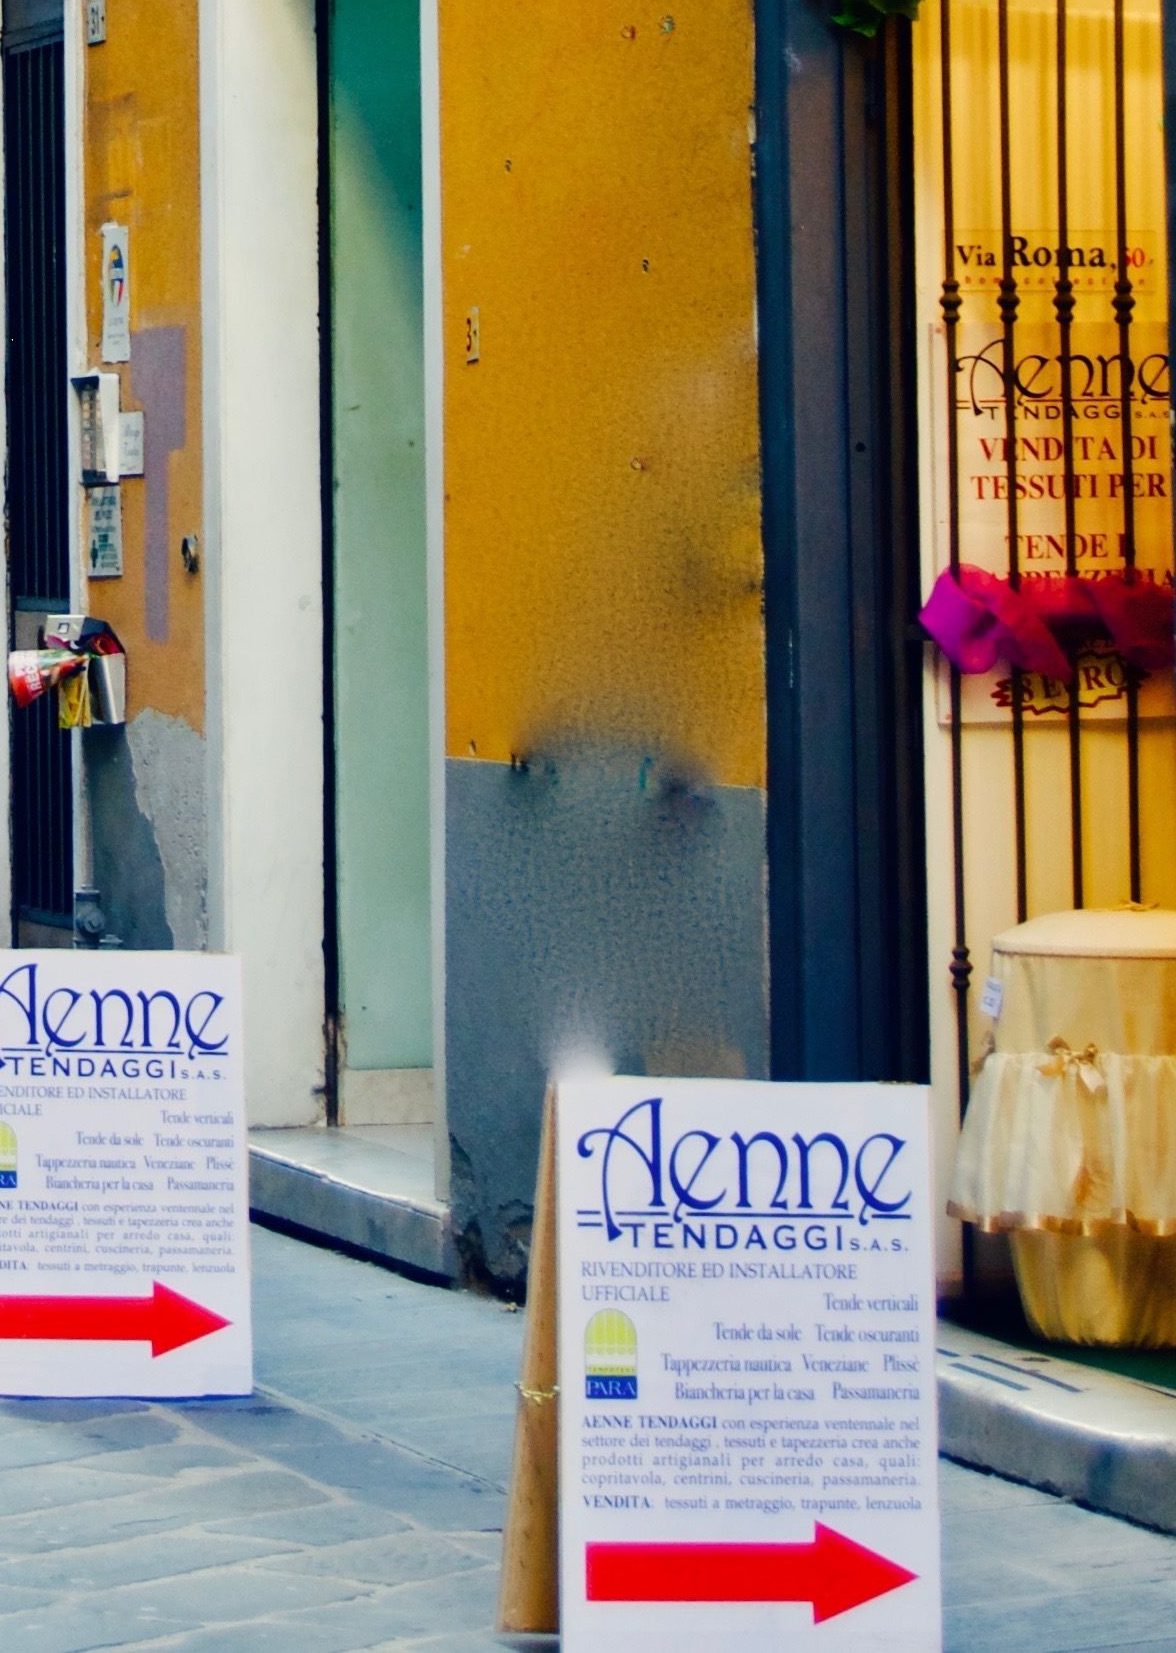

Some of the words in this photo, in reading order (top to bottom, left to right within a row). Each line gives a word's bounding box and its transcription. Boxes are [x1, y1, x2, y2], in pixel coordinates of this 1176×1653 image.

[956, 244, 996, 267] Via
[4, 1056, 175, 1079] TENDAGGI
[181, 1069, 227, 1081] S.A.S.
[67, 1086, 85, 1099] ED
[88, 1086, 187, 1100] INSTALLATORE
[577, 1097, 911, 1241] Aenne
[619, 1223, 843, 1252] TENDAGGI
[849, 1239, 909, 1253] S.A.S.
[581, 1261, 697, 1278] RIVENDITORE
[702, 1262, 724, 1279] ED
[729, 1262, 858, 1280] INSTALLATORE
[582, 1285, 670, 1302] UFFICIALE
[823, 1292, 864, 1311] Tende
[867, 1293, 919, 1311] verticali
[712, 1321, 755, 1341] Tende
[757, 1322, 773, 1341] da
[776, 1323, 802, 1341] sole
[814, 1323, 856, 1342] Tende
[858, 1325, 920, 1343] oscuranti
[661, 1352, 741, 1377] Tappezzeria
[744, 1356, 792, 1372] nautica
[801, 1353, 870, 1372] Veneziane
[587, 1380, 636, 1395] PARA
[675, 1382, 745, 1400] Biancheria
[748, 1387, 770, 1405] per
[773, 1382, 784, 1400] la
[787, 1388, 815, 1401] casa
[832, 1381, 920, 1401] Passamaneria
[582, 1415, 633, 1428] AENNE
[638, 1415, 717, 1429] TENDAGGI
[721, 1419, 746, 1429] con
[750, 1417, 820, 1434] esperienza
[824, 1417, 896, 1431] ventennale
[900, 1417, 920, 1431] nel
[581, 1434, 626, 1447] settore
[629, 1434, 650, 1448] dei
[655, 1433, 712, 1452] tendaggi
[724, 1435, 766, 1448] tessuti
[781, 1435, 848, 1452] tapezzeria
[852, 1439, 878, 1448] crea
[883, 1435, 920, 1449] anche
[582, 1452, 643, 1469] prodotti
[652, 1453, 731, 1470] artigianali
[742, 1456, 765, 1471] per
[775, 1453, 824, 1467] arredo
[664, 1496, 708, 1509] tessuti
[712, 1499, 720, 1509] a
[865, 1496, 922, 1510] lenzuola
